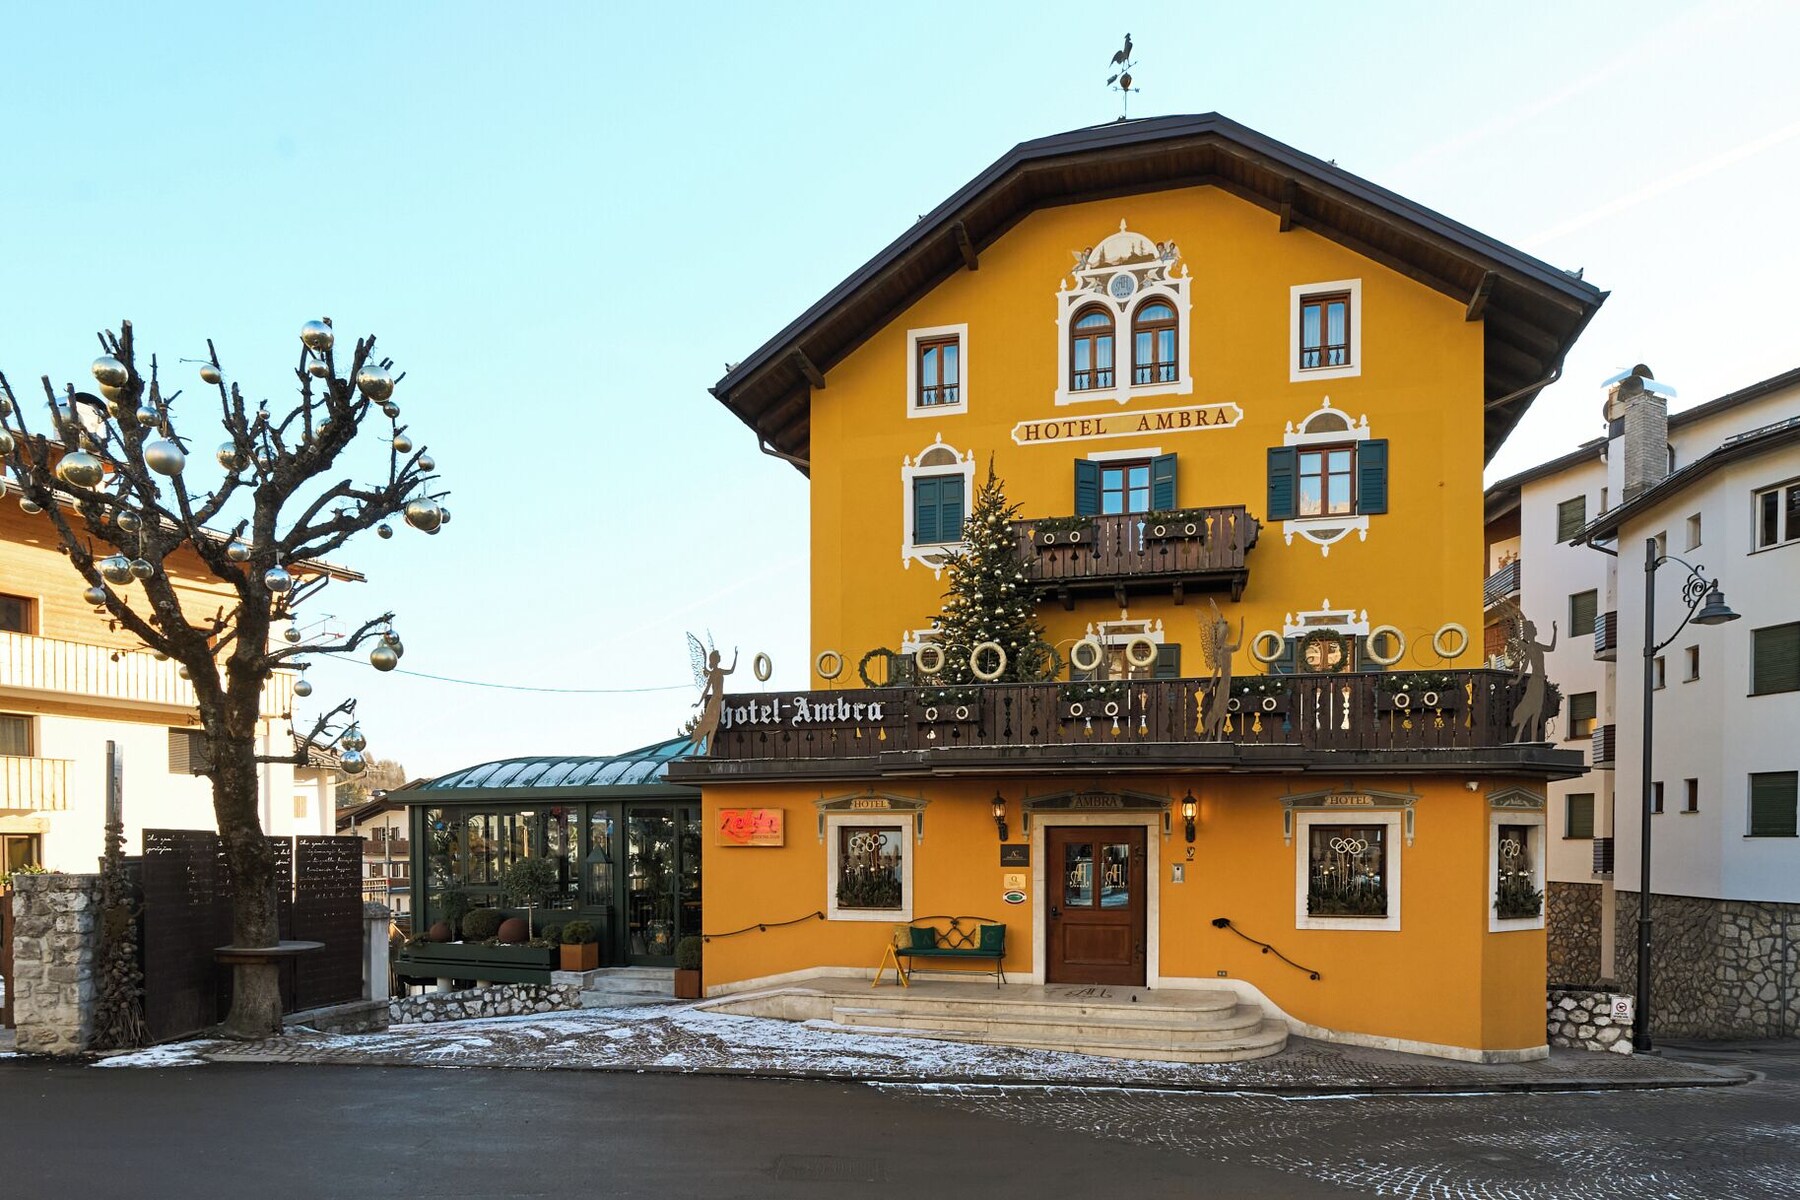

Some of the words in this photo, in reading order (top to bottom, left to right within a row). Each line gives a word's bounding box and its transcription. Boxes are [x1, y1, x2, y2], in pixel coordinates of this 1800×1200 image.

[1024, 418, 1107, 441] HOTEL
[1136, 407, 1229, 432] AMBRA
[720, 698, 782, 729] hotel
[792, 696, 884, 728] Ambra
[854, 800, 887, 808] HOTEL
[1075, 796, 1118, 807] AMBRA
[1329, 795, 1370, 805] HOTEL
